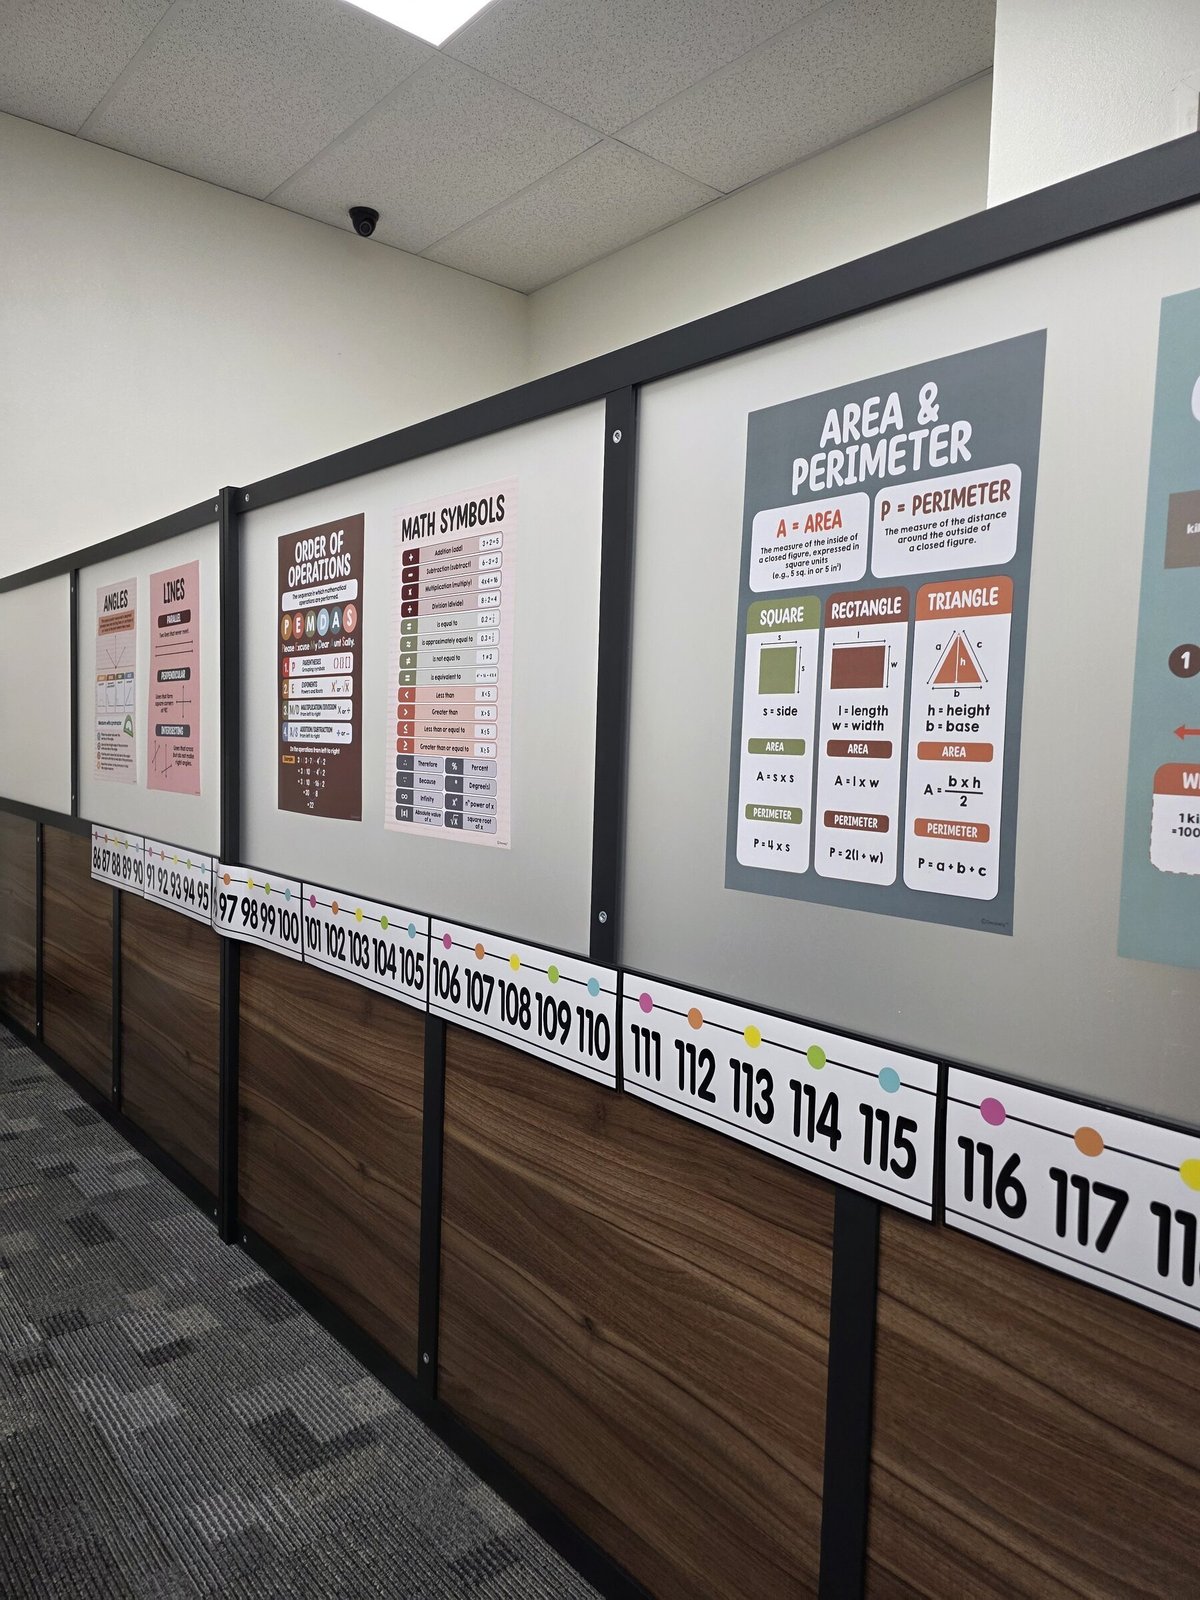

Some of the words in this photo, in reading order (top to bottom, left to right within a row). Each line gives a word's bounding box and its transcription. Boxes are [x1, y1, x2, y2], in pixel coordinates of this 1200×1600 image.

[820, 392, 904, 449] AREA
[917, 382, 940, 425] &
[792, 420, 973, 496] PERIMETER
[881, 501, 891, 521] P
[912, 479, 1011, 516] PERIMETER
[402, 511, 436, 542] MATH
[440, 494, 505, 534] SYMBOLS
[777, 519, 787, 538] A
[804, 509, 842, 534] AREA
[885, 528, 899, 536] The
[901, 522, 938, 534] measure
[940, 519, 949, 527] of
[951, 516, 965, 526] the
[968, 512, 1007, 524] distance
[773, 543, 804, 553] measure
[805, 540, 813, 548] of
[827, 536, 849, 545] inside
[850, 533, 859, 541] of
[898, 533, 928, 544] around
[930, 531, 944, 540] the
[946, 525, 979, 537] outside
[981, 523, 991, 532] of
[917, 540, 945, 551] closed
[946, 538, 977, 548] figure.
[295, 535, 326, 564] ORDER
[330, 530, 344, 555] OF
[765, 553, 787, 563] closed
[813, 544, 851, 555] expressed
[288, 553, 351, 588] OPERATIONS
[785, 560, 810, 569] square
[812, 557, 829, 565] units
[104, 589, 129, 613] ANGLES
[163, 578, 185, 604] LINES
[928, 587, 999, 611] TRIANGLE
[760, 606, 805, 627] SQUARE
[832, 597, 902, 620] RECTANGLE
[1181, 652, 1191, 670] 1
[763, 708, 768, 716] s
[776, 706, 798, 717] side
[851, 705, 889, 719] length
[928, 704, 935, 716] h
[947, 704, 991, 719] height
[832, 722, 842, 731] w
[852, 720, 884, 732] width
[926, 720, 934, 732] b
[946, 720, 980, 733] base
[452, 745, 464, 753] equal
[766, 741, 784, 752] AREA
[848, 744, 869, 755] AREA
[942, 746, 967, 758] AREA
[753, 807, 792, 821] PERIMETER
[834, 815, 878, 829] PERIMETER
[927, 822, 978, 838] PERIMETER
[93, 846, 101, 870] 86
[102, 849, 111, 873] 87
[112, 853, 121, 877] 88
[123, 854, 132, 880] 89
[134, 859, 144, 885] 90
[147, 864, 155, 890] 91
[158, 867, 168, 895] 92
[171, 872, 181, 900] 93
[183, 876, 195, 905] 94
[198, 881, 209, 911] 95
[219, 893, 238, 924] 97
[241, 897, 259, 930] 98
[261, 902, 276, 935] 99
[278, 908, 300, 944] 100
[305, 916, 321, 952] 101
[325, 922, 346, 961] 102
[348, 930, 370, 970] 103
[373, 938, 397, 980] 104
[400, 946, 425, 991] 105
[433, 958, 461, 1004] 106
[465, 968, 495, 1015] 107
[499, 979, 532, 1031] 108
[536, 992, 572, 1046] 109
[576, 1006, 611, 1062] 110
[631, 1024, 661, 1082] 111
[675, 1039, 716, 1103] 112
[729, 1058, 775, 1125] 113
[789, 1079, 842, 1152] 114
[859, 1103, 918, 1180] 115
[958, 1135, 1027, 1219] 116
[1049, 1167, 1129, 1254] 117
